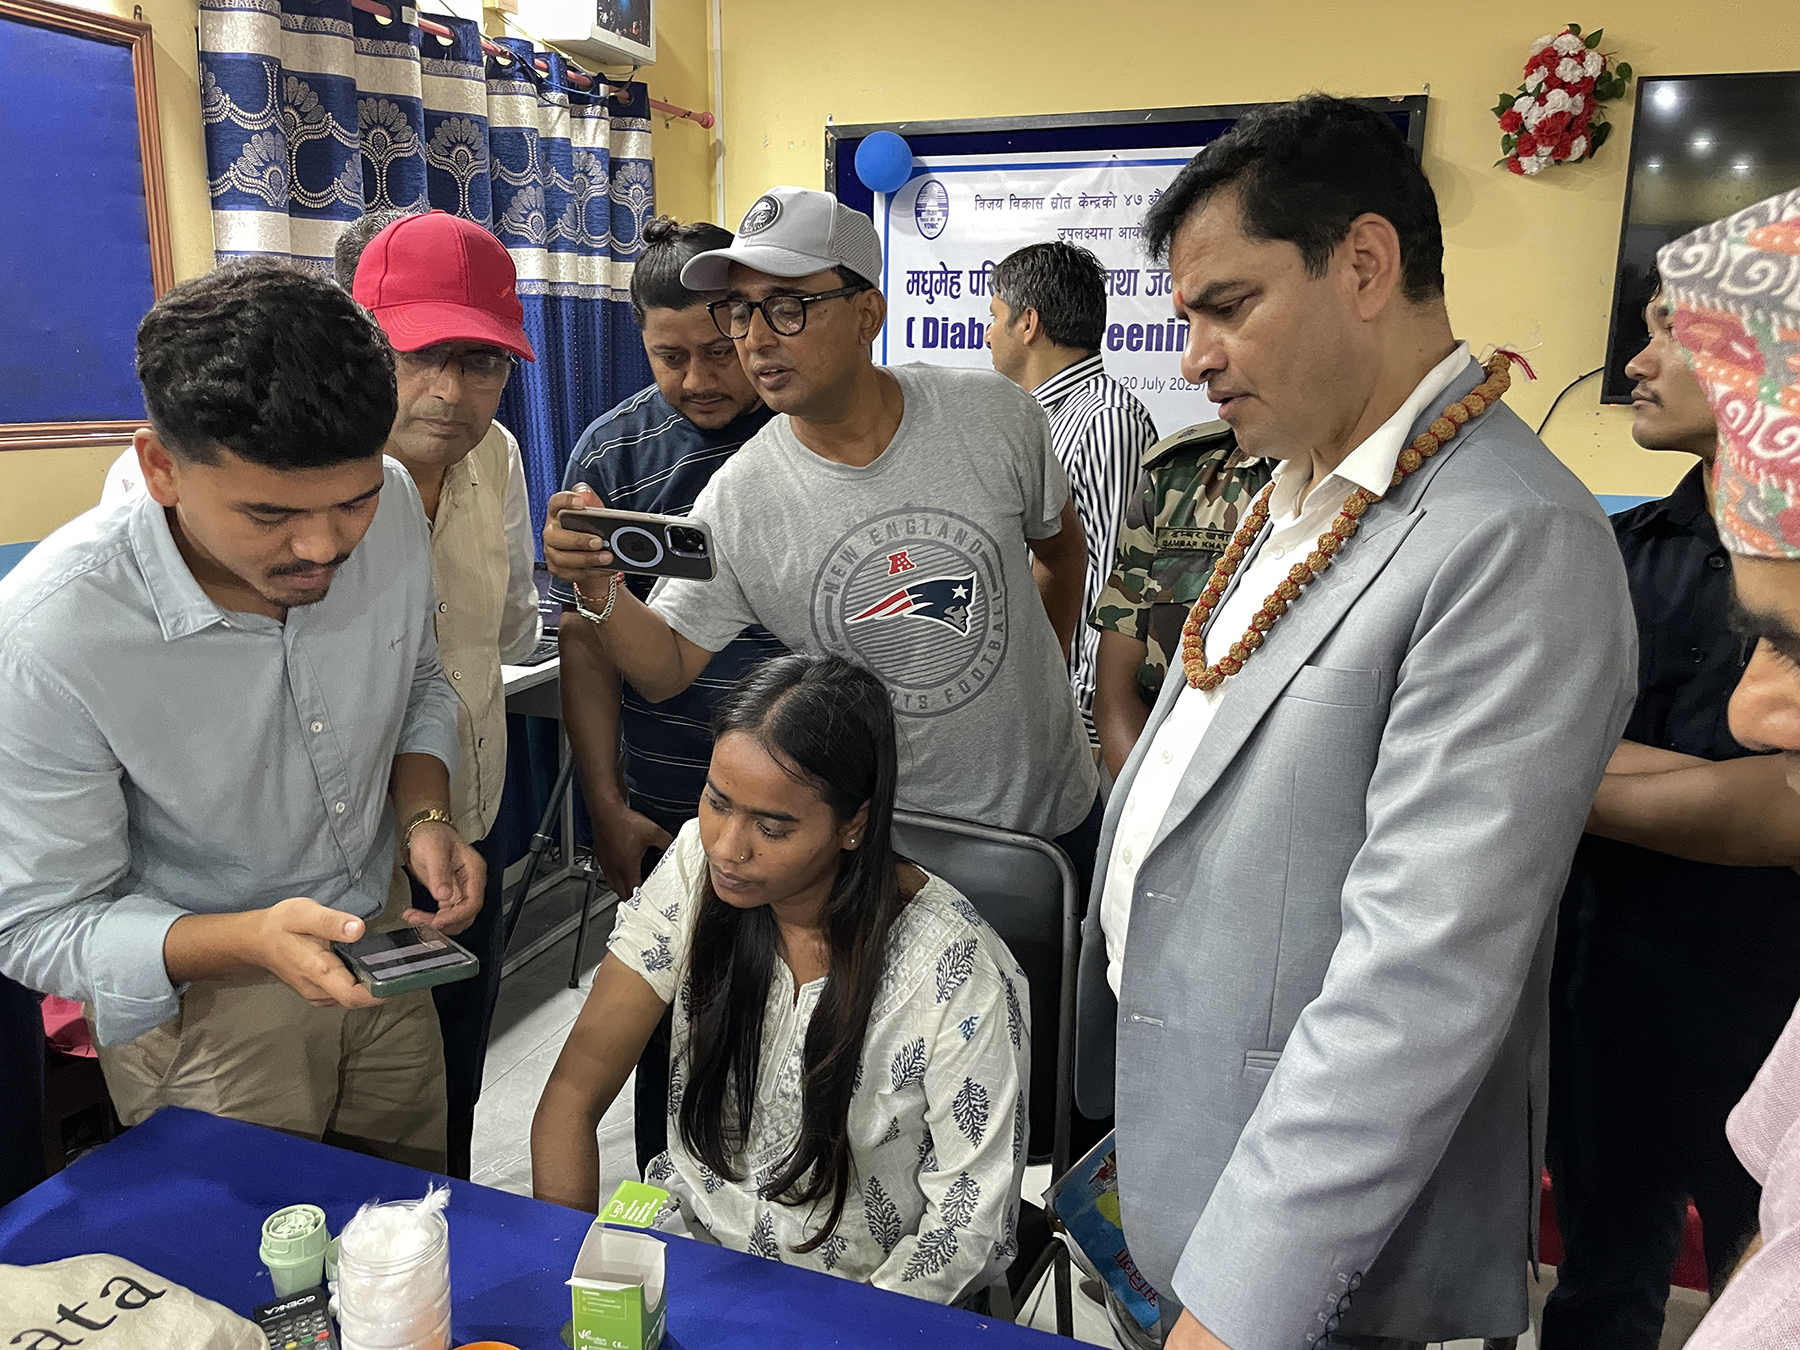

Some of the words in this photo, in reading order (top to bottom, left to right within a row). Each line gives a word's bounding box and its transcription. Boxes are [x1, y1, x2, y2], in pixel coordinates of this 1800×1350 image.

[975, 195, 1004, 211] विजय
[1009, 193, 1045, 211] विकास
[1078, 191, 1117, 209] केन्द्रको
[1124, 193, 1142, 206] ४७
[1057, 227, 1113, 241] उपलक्ष्यमा
[905, 261, 963, 305] मधुमेह
[922, 317, 992, 349] Diab
[1141, 377, 1166, 393] July
[823, 545, 860, 596] NEW
[868, 518, 986, 555] ENGLAND
[943, 590, 1004, 704] FOOTBALL
[263, 1295, 316, 1315] GOENKA
